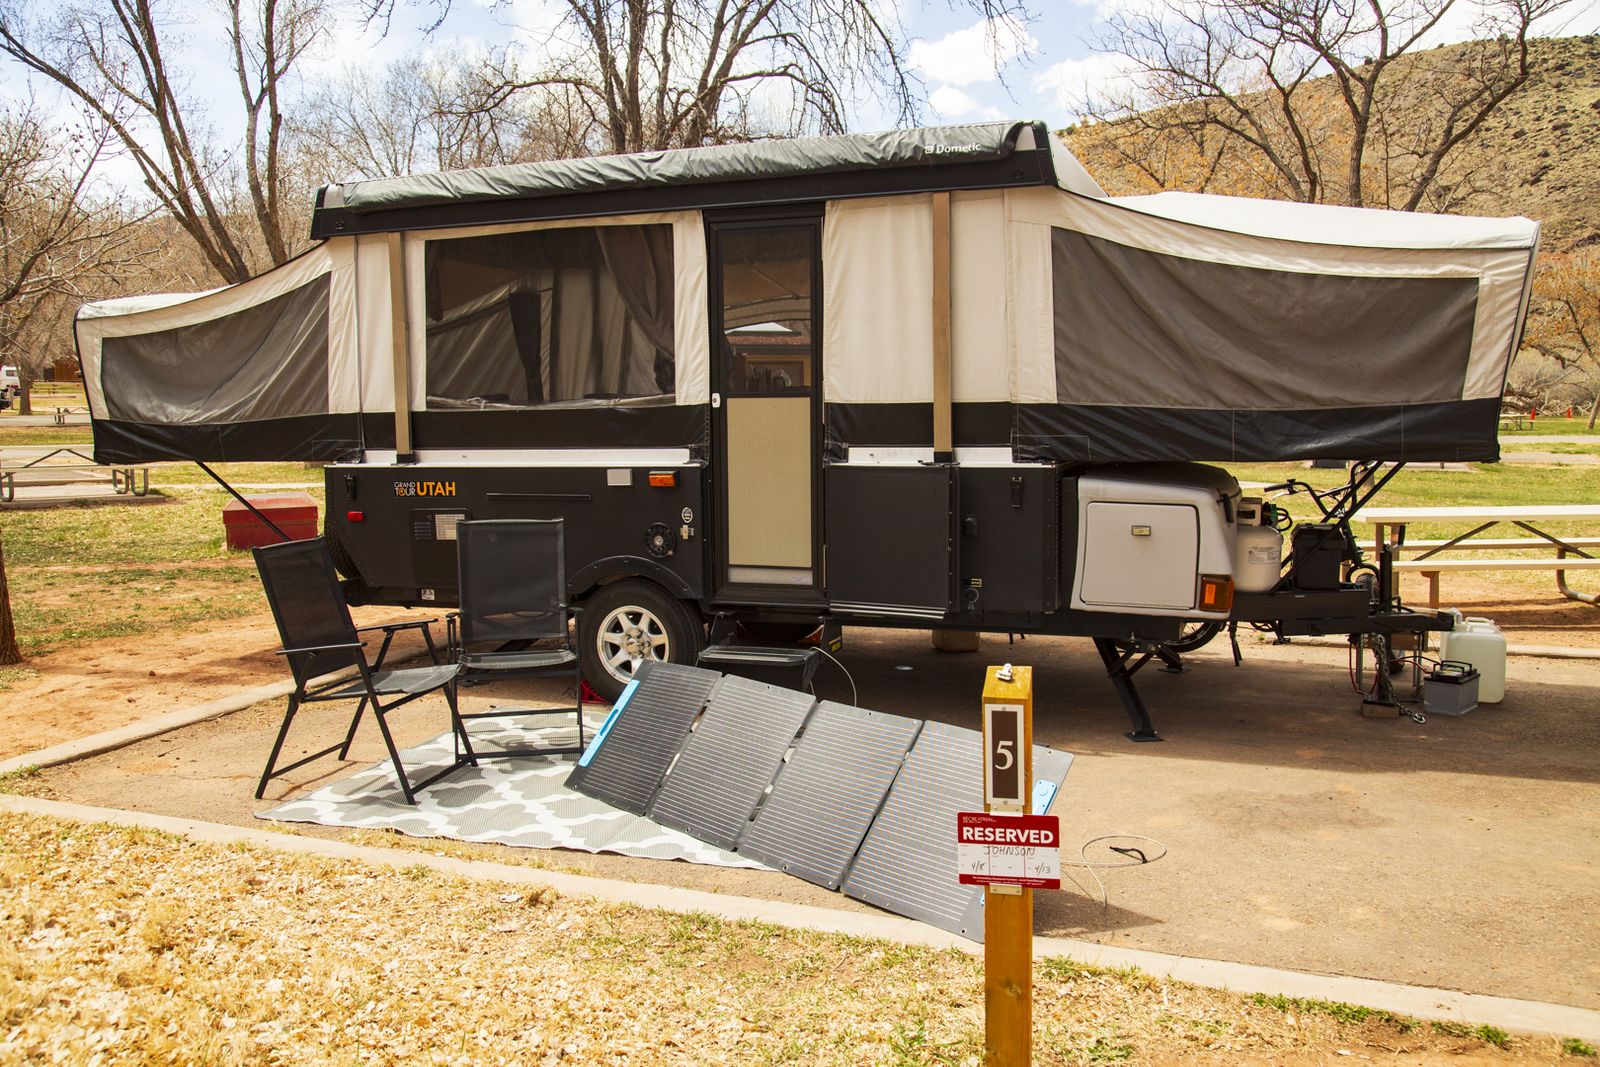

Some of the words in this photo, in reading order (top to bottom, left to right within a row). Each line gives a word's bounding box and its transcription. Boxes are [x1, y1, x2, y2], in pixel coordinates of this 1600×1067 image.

[935, 142, 982, 154] Dometic
[394, 487, 416, 497] TOUR
[416, 481, 456, 497] UTAH
[994, 740, 1014, 770] 5
[962, 826, 1054, 844] RESERVED
[983, 845, 1036, 856] JOHNSON
[971, 860, 986, 873] 4/8
[1034, 861, 1052, 877] 4/13
